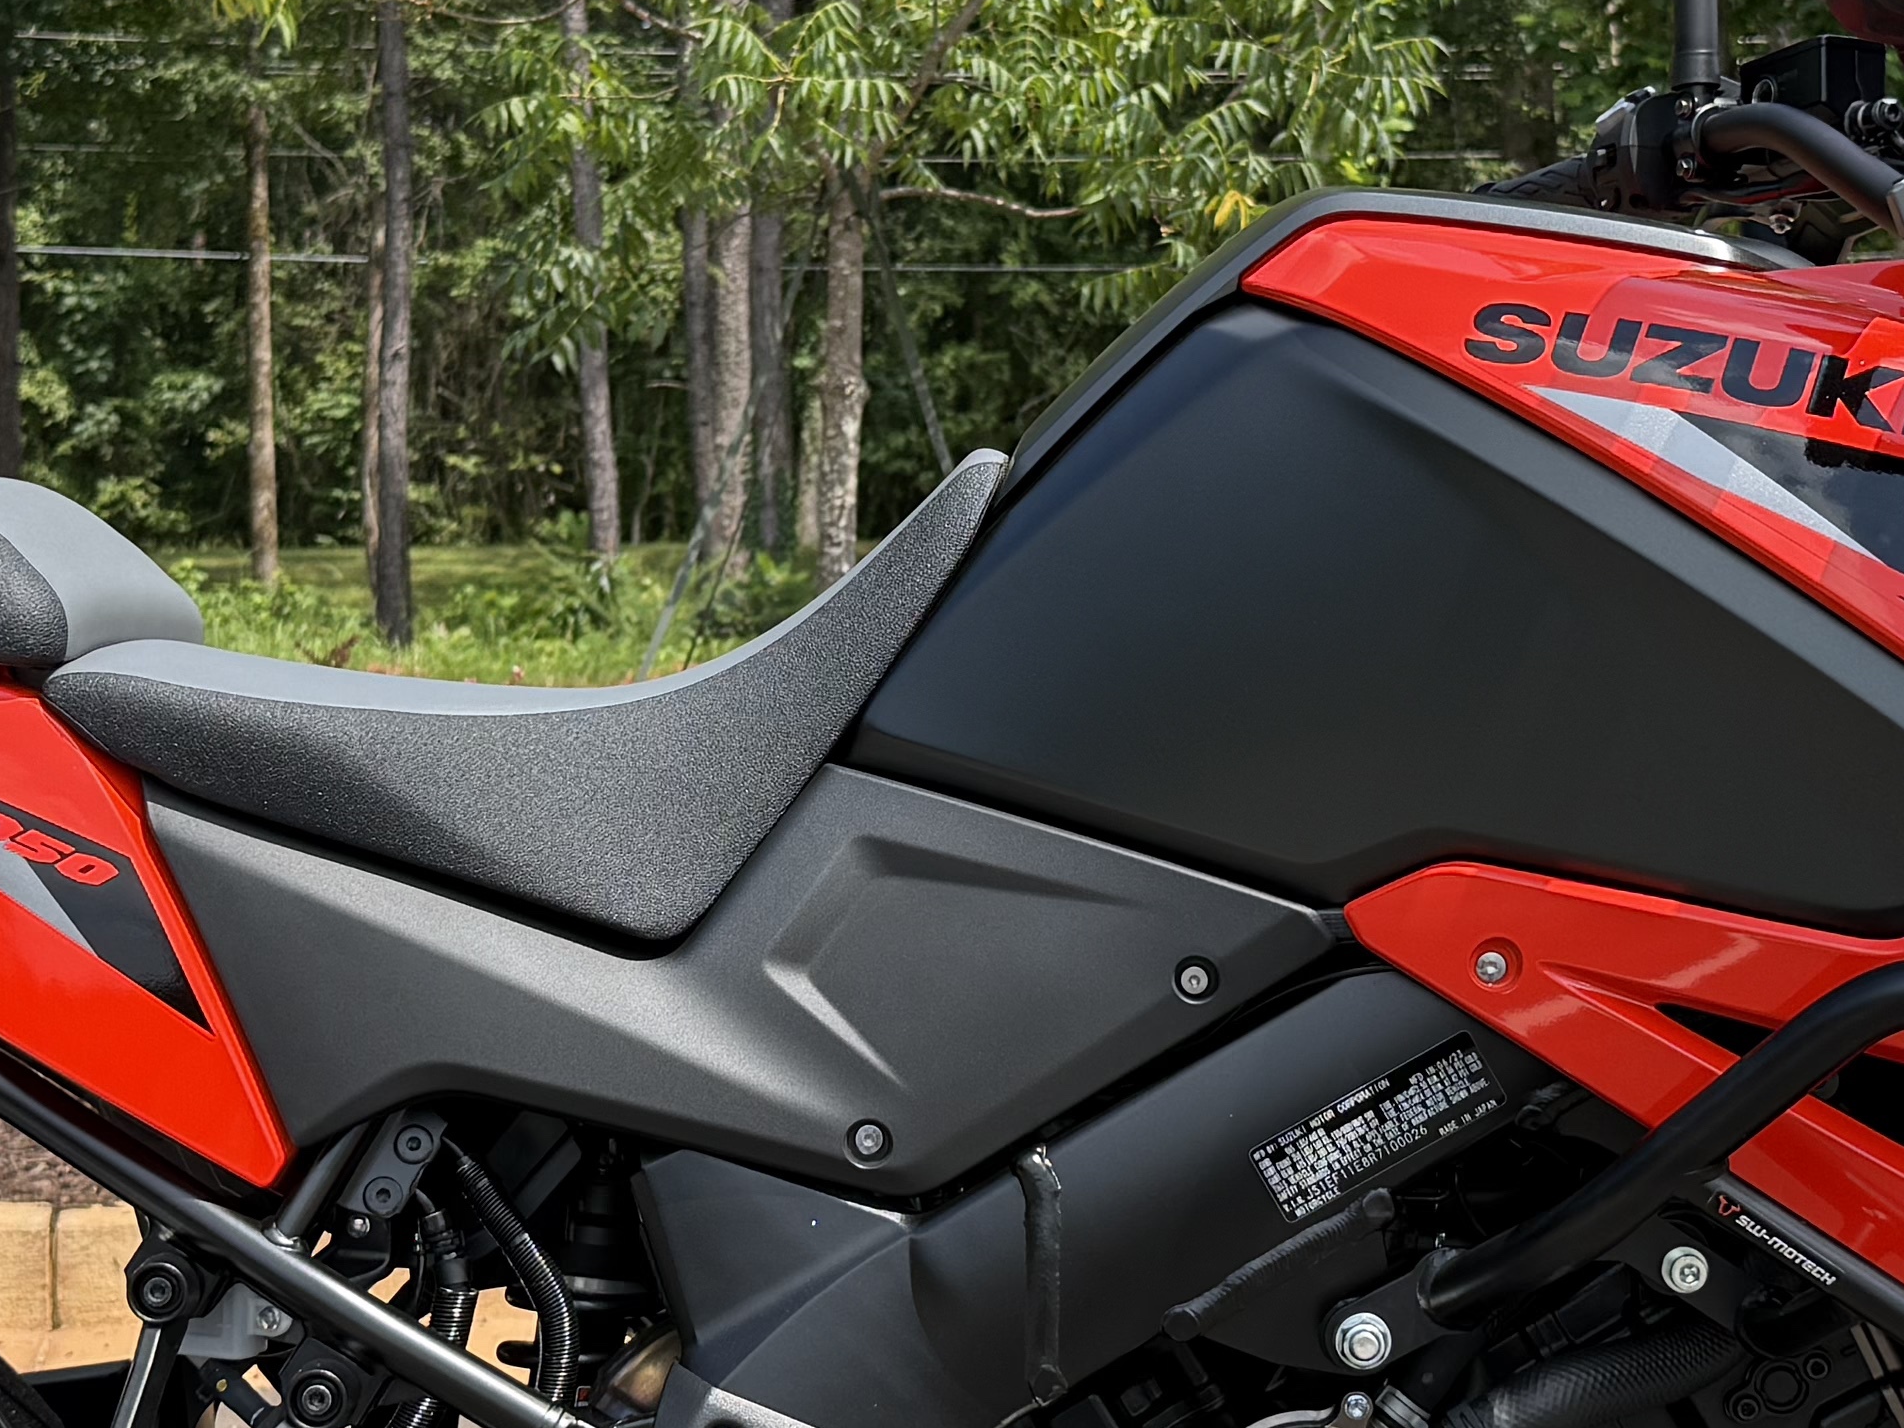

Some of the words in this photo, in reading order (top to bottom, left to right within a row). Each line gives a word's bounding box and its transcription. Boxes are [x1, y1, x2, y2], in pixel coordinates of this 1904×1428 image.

[1277, 1125, 1306, 1146] SUZUKI
[1308, 1109, 1335, 1128] MOTOR
[1335, 1078, 1390, 1113] CORPORATION
[1438, 1120, 1458, 1135] MADE
[1473, 1098, 1497, 1116] JAPAN
[1734, 1212, 1837, 1286] SW-MOTECH
